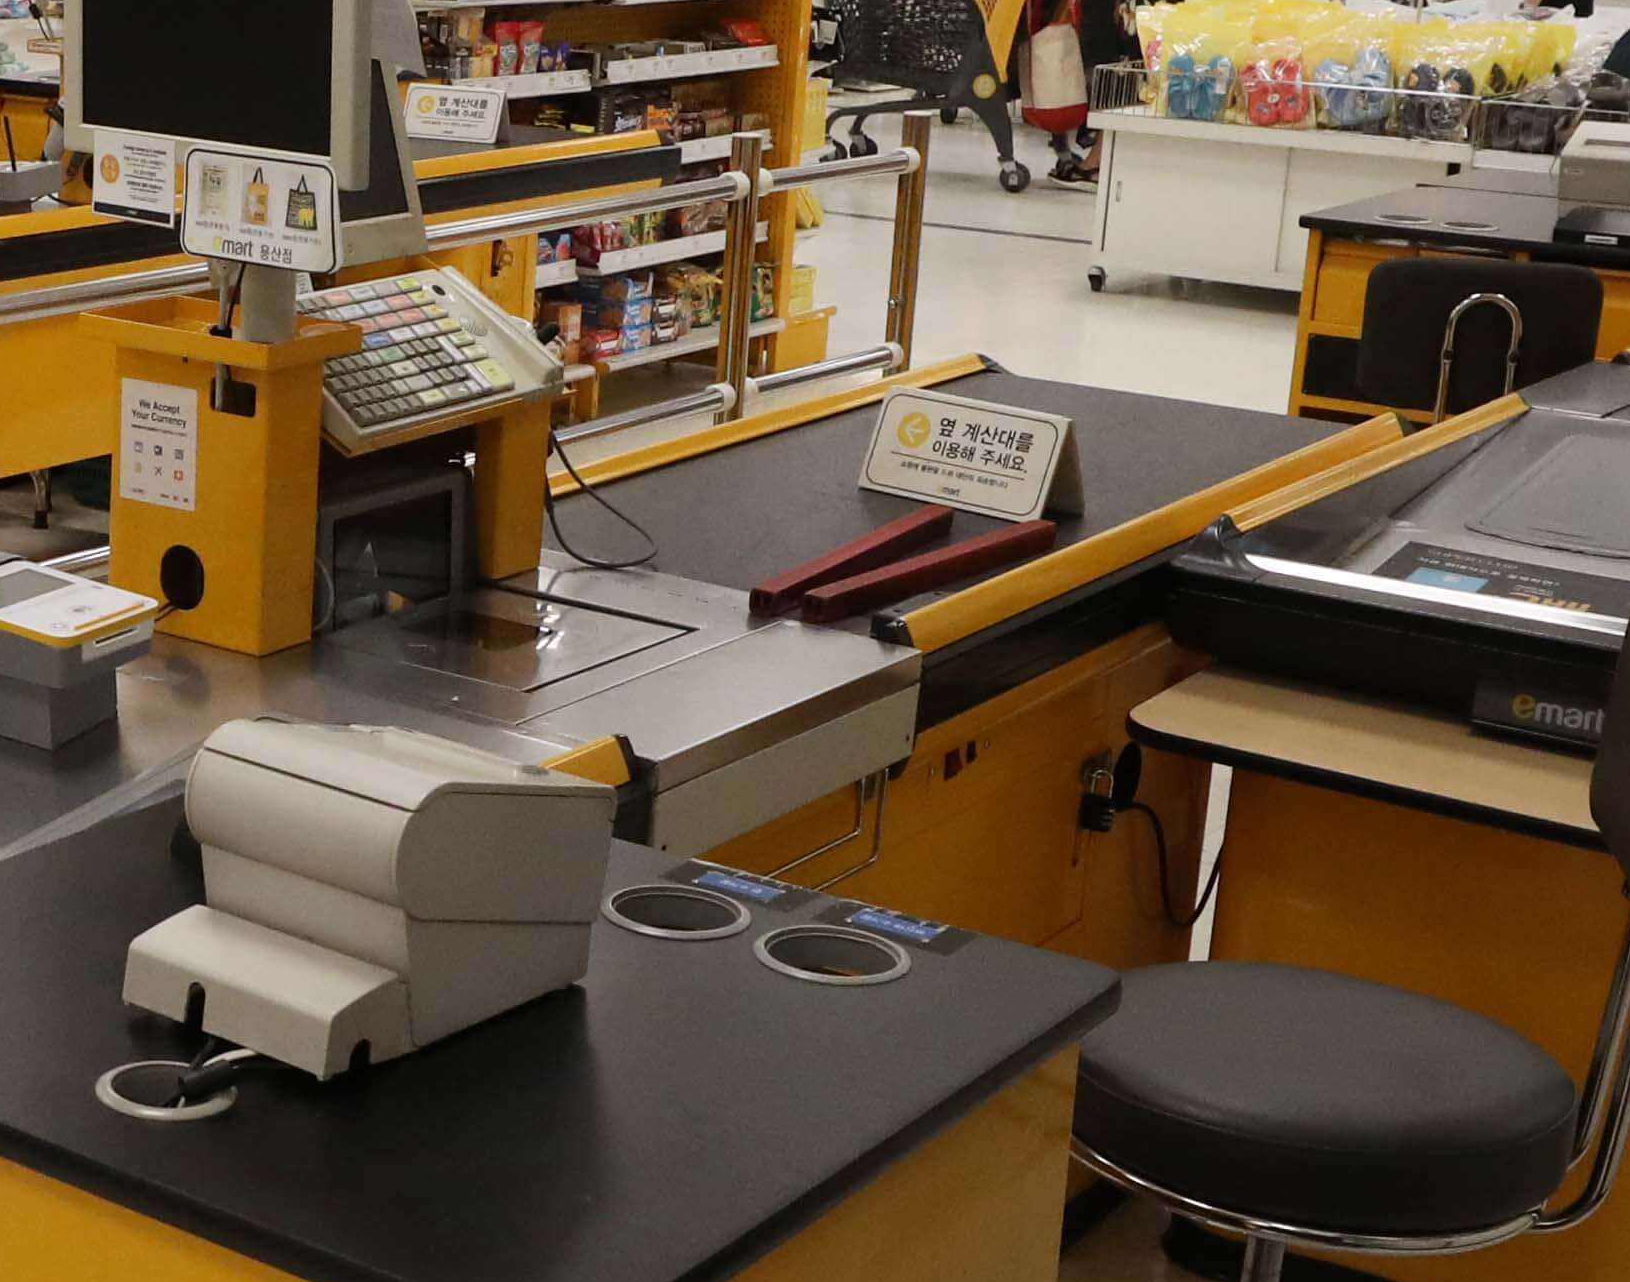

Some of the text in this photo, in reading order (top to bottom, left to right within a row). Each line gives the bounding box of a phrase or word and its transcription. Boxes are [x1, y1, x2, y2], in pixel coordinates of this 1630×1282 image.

[132, 408, 187, 429] Your Currency
[138, 398, 181, 415] We Accept
[939, 416, 1035, 453] 옆 계산대를
[932, 440, 1028, 474] 이용해 주세요.
[1512, 693, 1605, 734] emart
